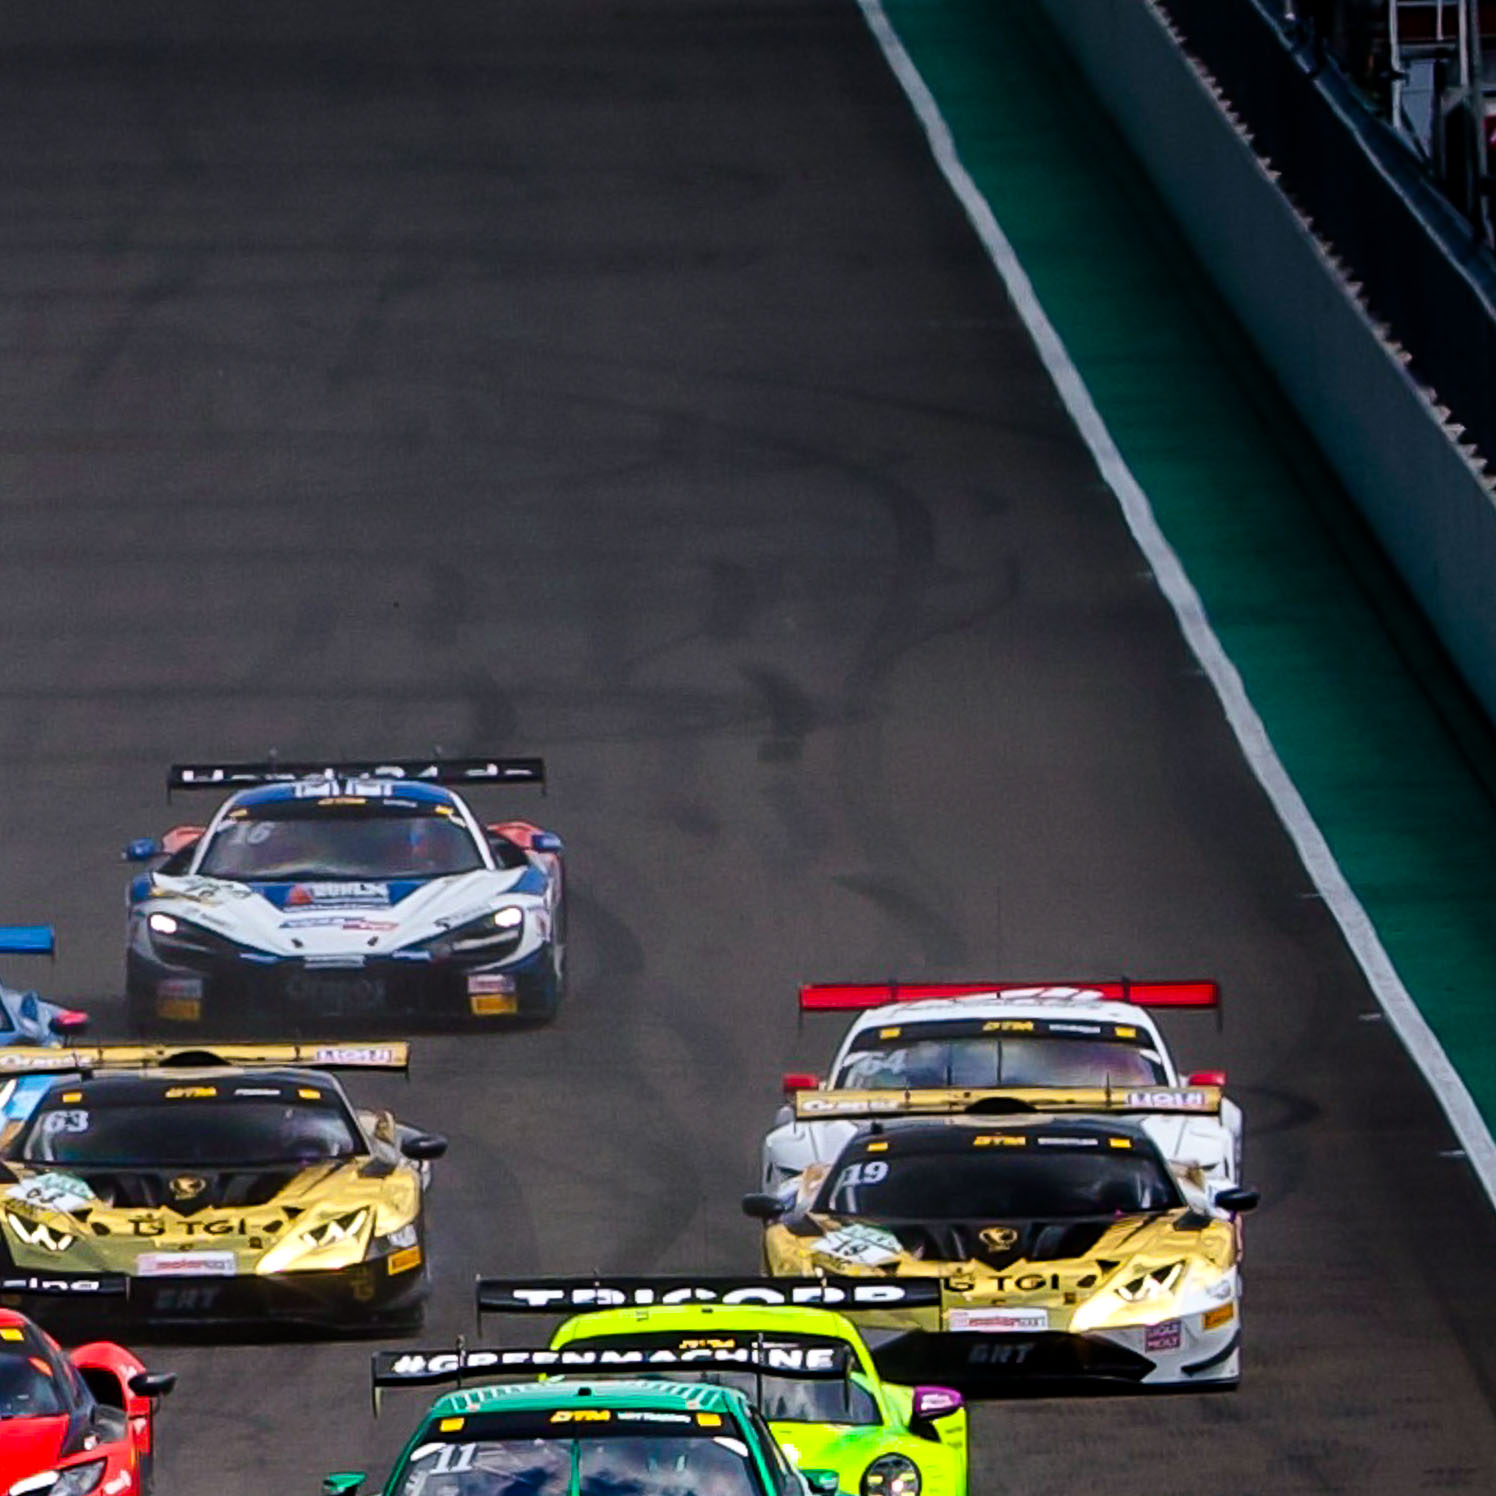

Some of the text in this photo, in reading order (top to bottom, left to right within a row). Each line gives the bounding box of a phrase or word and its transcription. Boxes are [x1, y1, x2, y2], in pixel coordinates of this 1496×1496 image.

[230, 822, 271, 846] 16
[45, 1110, 90, 1133] 63
[844, 1161, 889, 1185] 19
[176, 1220, 248, 1236] TGI
[996, 1275, 1060, 1290] TGI
[391, 1348, 838, 1374] #GREENMACHINE
[550, 1410, 611, 1422] DTM
[434, 1444, 477, 1473] 11
